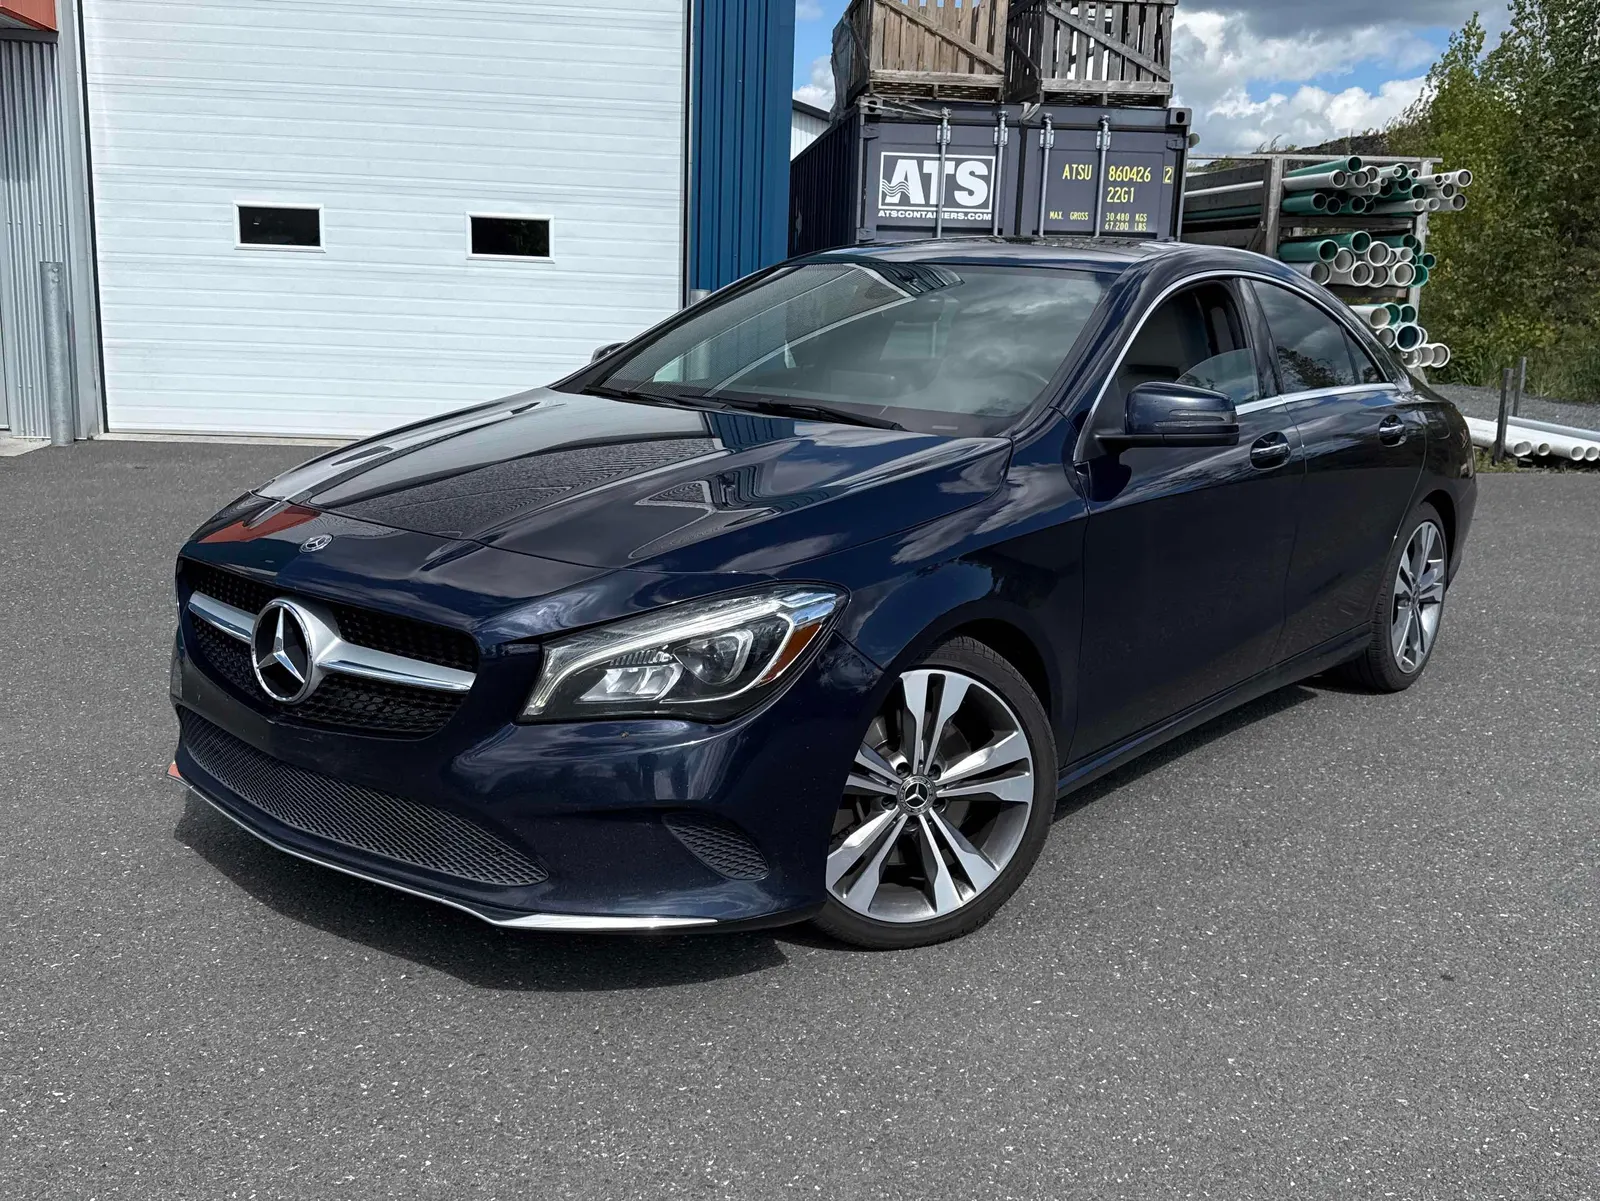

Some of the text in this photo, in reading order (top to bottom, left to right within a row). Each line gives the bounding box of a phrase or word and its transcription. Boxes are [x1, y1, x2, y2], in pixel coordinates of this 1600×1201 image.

[1062, 164, 1173, 183] ATSU 860426 2
[884, 158, 989, 207] ATS
[1106, 186, 1135, 203] 22G1
[878, 210, 992, 221] ATSCONTAIERS.COM
[1070, 211, 1089, 221] GROSS
[1135, 213, 1148, 222] KGS
[1134, 222, 1147, 231] LBS
